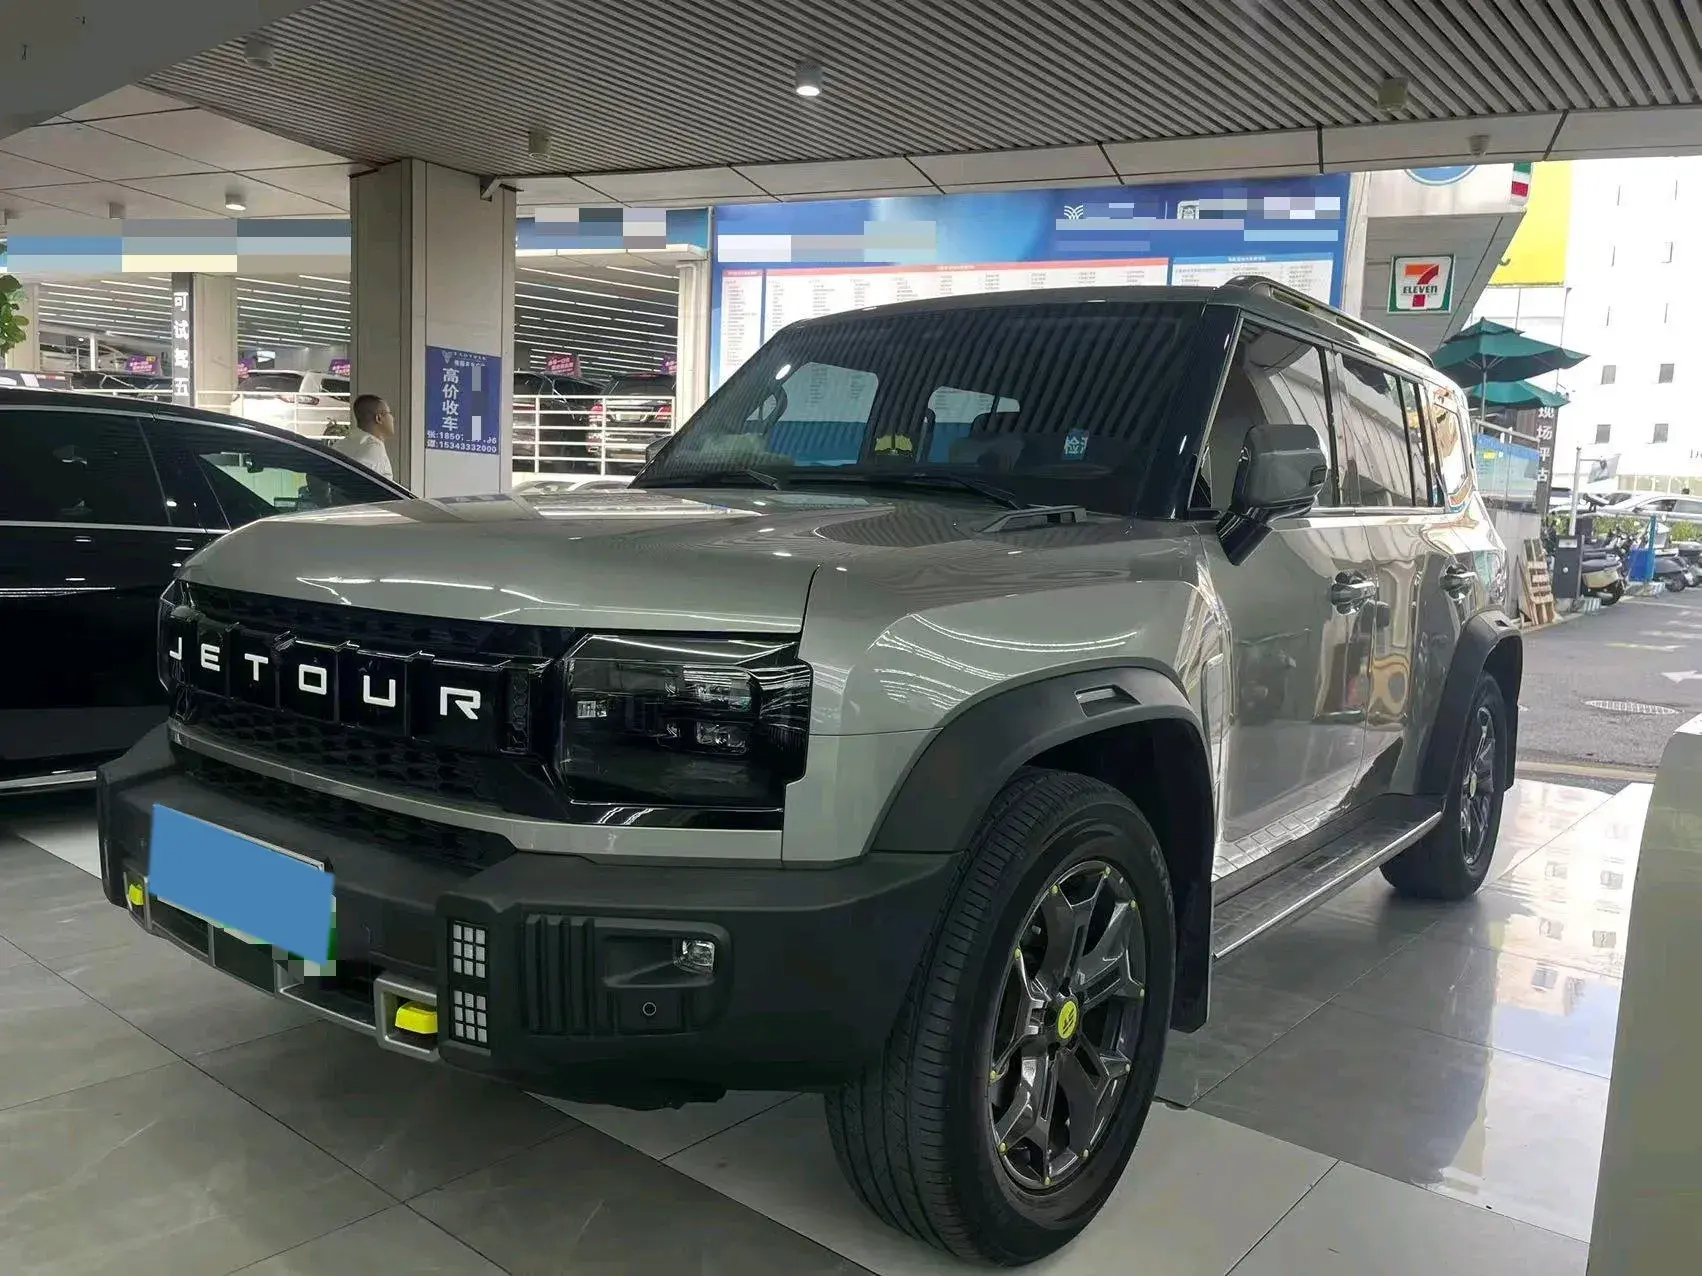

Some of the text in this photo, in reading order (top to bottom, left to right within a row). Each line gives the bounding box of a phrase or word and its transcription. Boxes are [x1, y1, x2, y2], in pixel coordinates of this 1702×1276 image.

[442, 367, 459, 431] 高价收车
[169, 636, 482, 720] JETOUR
